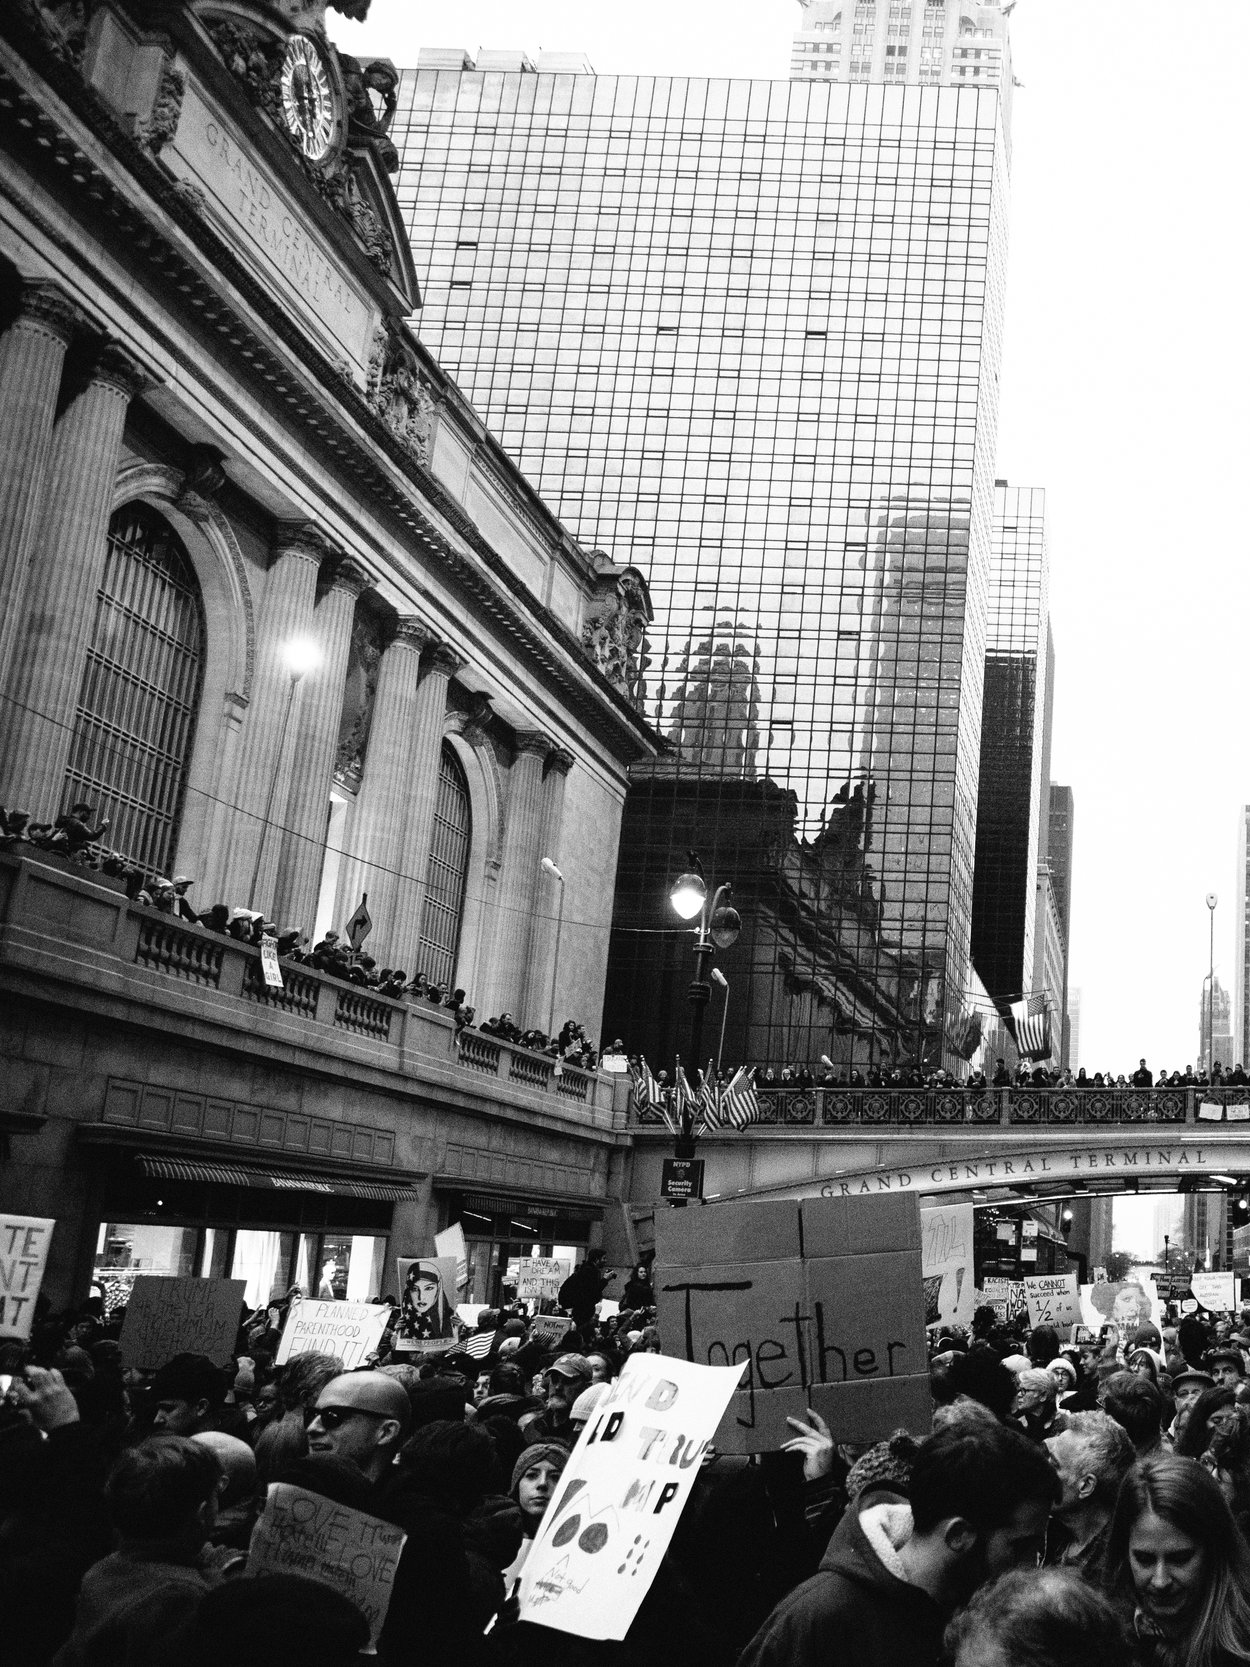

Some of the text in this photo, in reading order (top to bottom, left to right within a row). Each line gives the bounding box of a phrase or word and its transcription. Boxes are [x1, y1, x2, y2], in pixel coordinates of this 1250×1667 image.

[206, 123, 351, 314] GRAND CENTRAL
[239, 188, 319, 303] TERMINAL
[820, 1150, 1208, 1199] GRAND CENTRAL TERMINAL
[667, 1179, 693, 1188] Security
[667, 1185, 692, 1193] Camera
[531, 1266, 560, 1275] DREAM
[532, 1259, 551, 1268] HAVE
[522, 1277, 560, 1287] AND THIS
[1026, 1281, 1037, 1290] We
[1038, 1278, 1066, 1289] CANNOT
[1029, 1290, 1054, 1299] succeed
[315, 1302, 369, 1322] PLANNED
[1035, 1299, 1054, 1322] 1/2
[1056, 1302, 1063, 1312] of
[294, 1320, 361, 1338] PARENTHOOD
[273, 1484, 352, 1542] LOVE
[338, 1543, 398, 1584] LOVE
